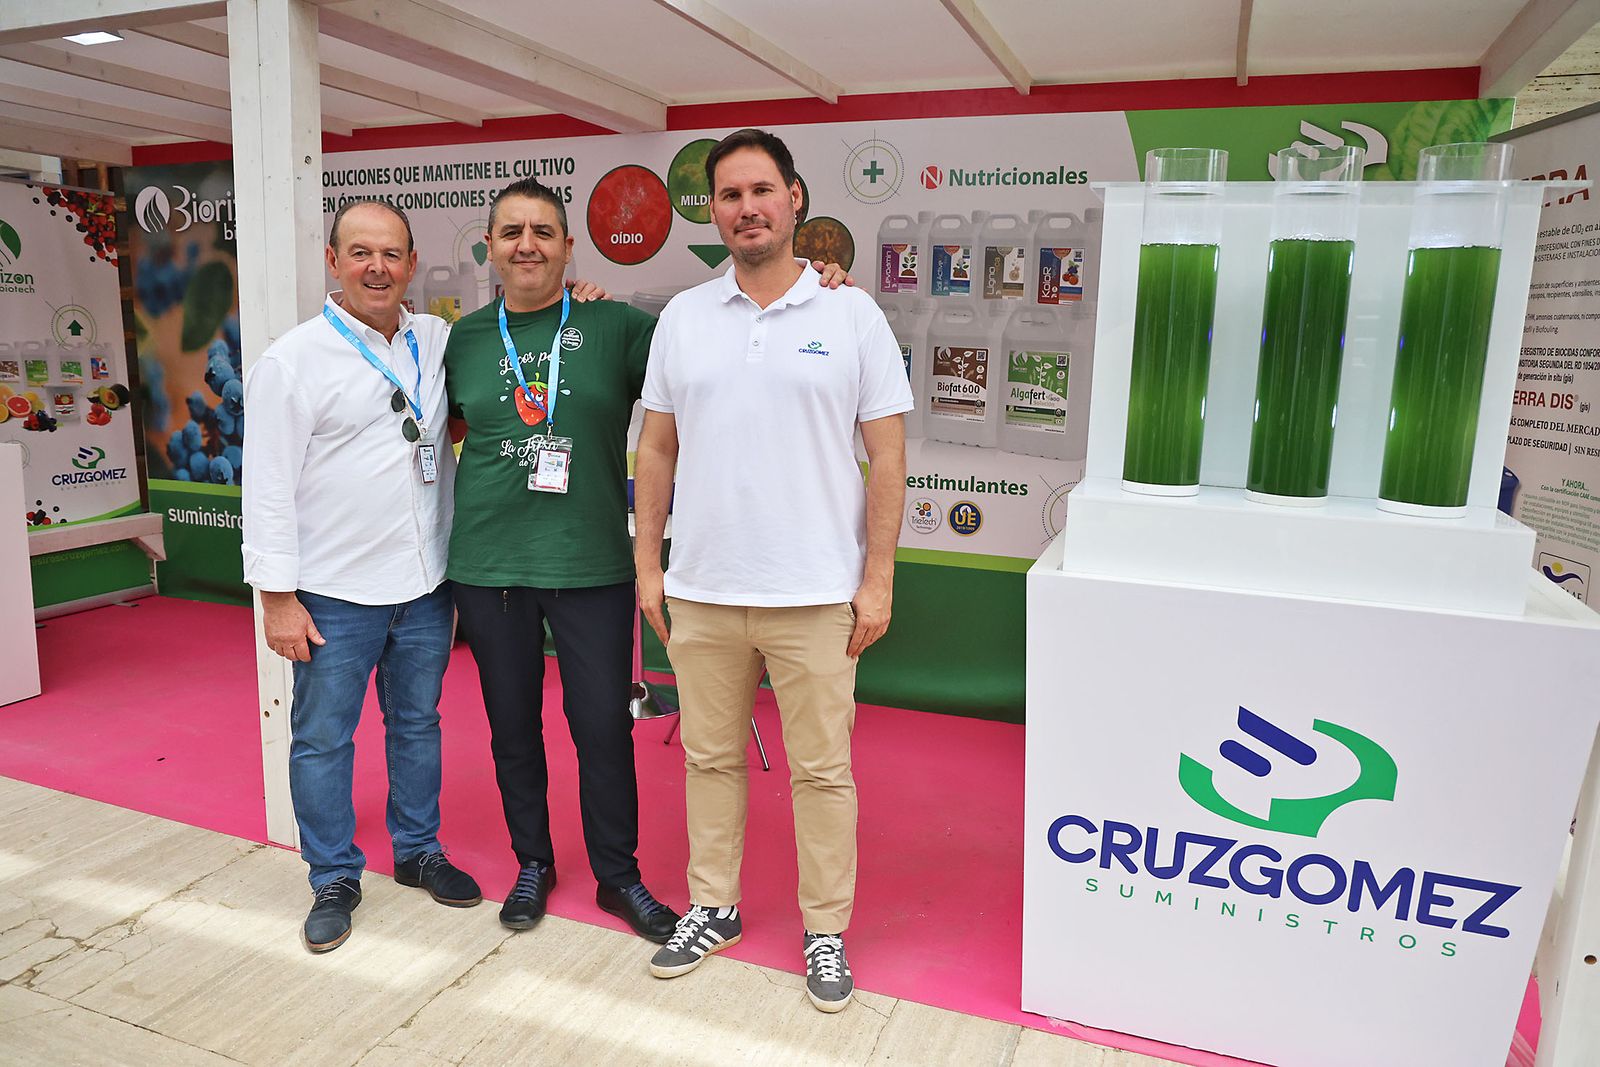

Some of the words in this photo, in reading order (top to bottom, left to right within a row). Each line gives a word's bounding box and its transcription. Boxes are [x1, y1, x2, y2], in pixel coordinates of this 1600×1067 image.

[394, 166, 420, 185] QUE
[423, 162, 491, 182] MANTIENE
[495, 161, 510, 178] EL
[514, 157, 575, 177] CULTIVO
[949, 165, 1088, 187] Nutricionales
[172, 185, 236, 232] Biori
[396, 189, 485, 210] CONDICIONES
[610, 231, 643, 244] OÍDIO
[937, 382, 961, 397] Biofat
[962, 384, 980, 394] 600
[1010, 388, 1046, 405] Algafert
[1517, 418, 1549, 431] COMPLETO
[1549, 421, 1566, 433] DEL
[1523, 437, 1533, 448] DE
[1532, 439, 1568, 452] SEGURIDAD
[52, 468, 127, 486] CRUZGOMEZ
[906, 473, 1028, 496] estimulantes
[954, 511, 977, 526] UE
[1047, 815, 1523, 939] CRUZGOMEZ
[1085, 878, 1457, 957] SUMINISTROS
